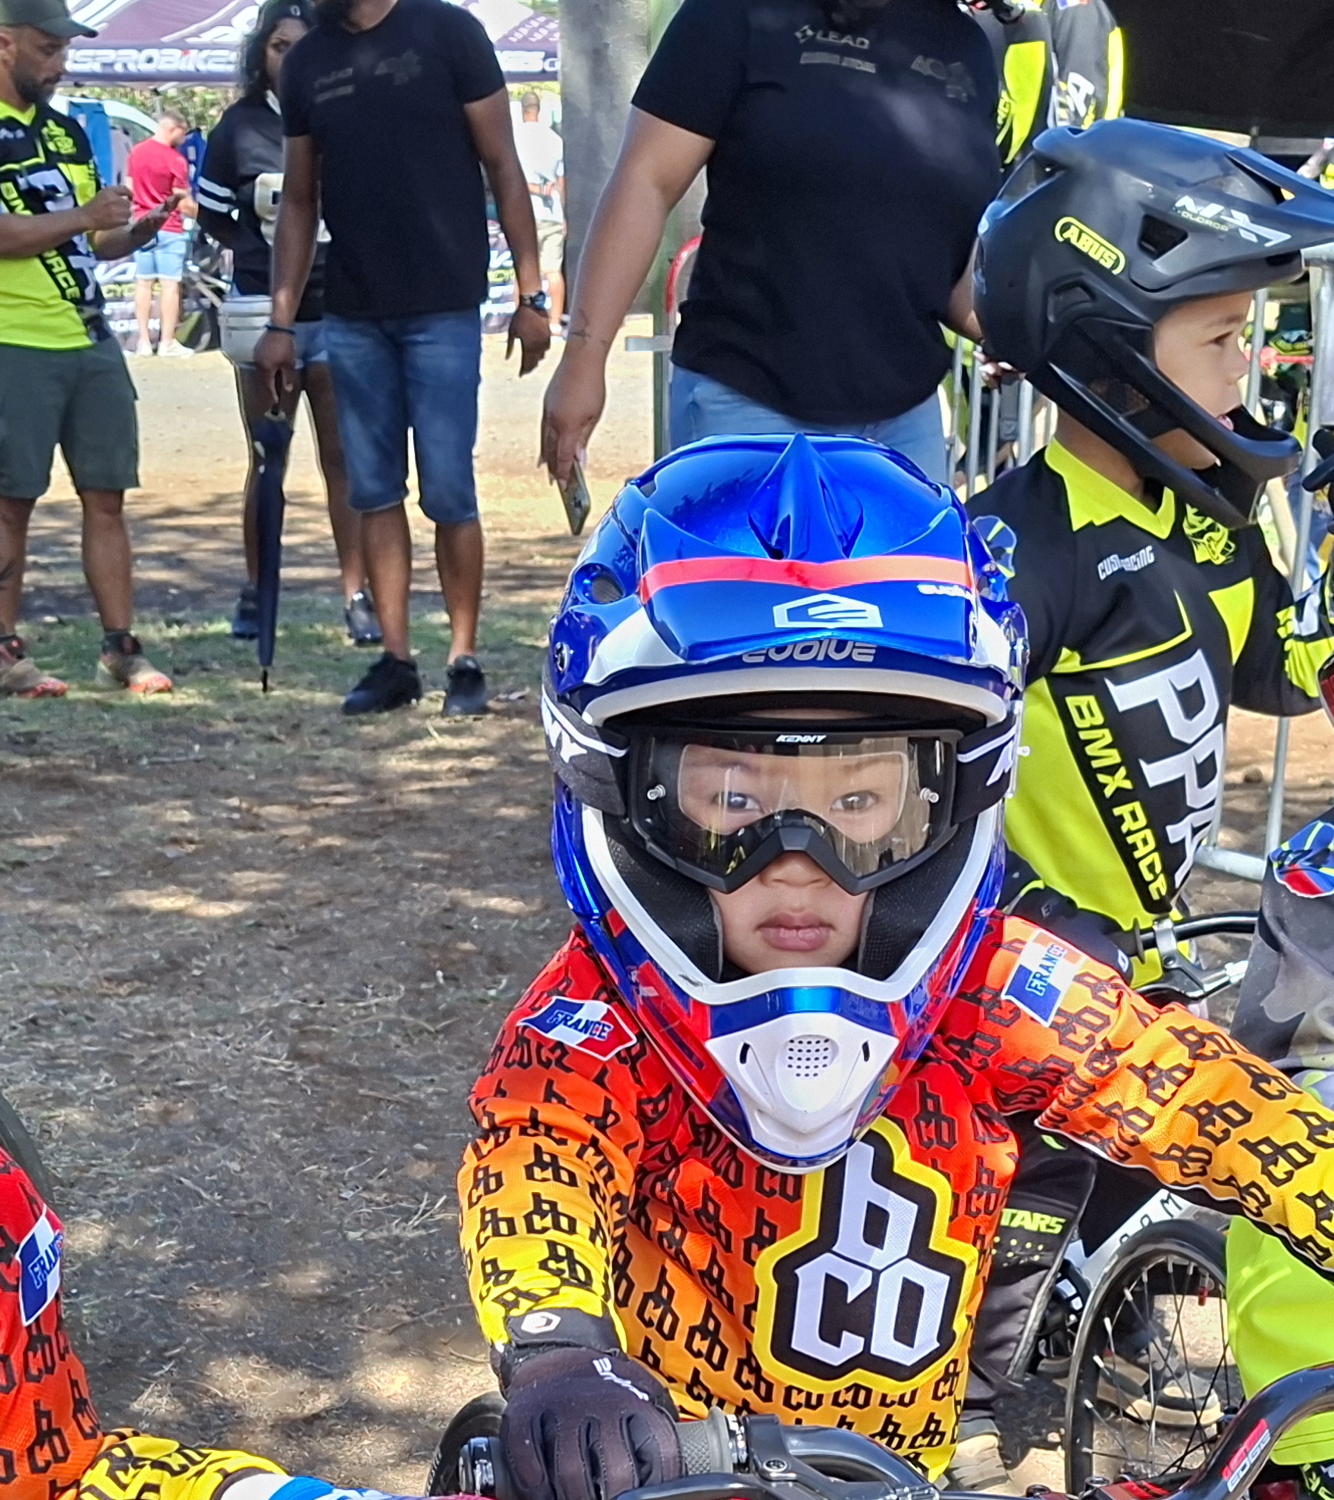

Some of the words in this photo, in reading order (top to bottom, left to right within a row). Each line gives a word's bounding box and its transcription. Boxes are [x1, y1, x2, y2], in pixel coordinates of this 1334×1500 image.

[1062, 223, 1119, 270] ABUS
[775, 734, 827, 743] KENNY
[1065, 695, 1133, 798] BMX
[1112, 801, 1169, 901] RACE
[1025, 943, 1067, 997] FRANCE
[547, 1010, 614, 1042] FRANCE
